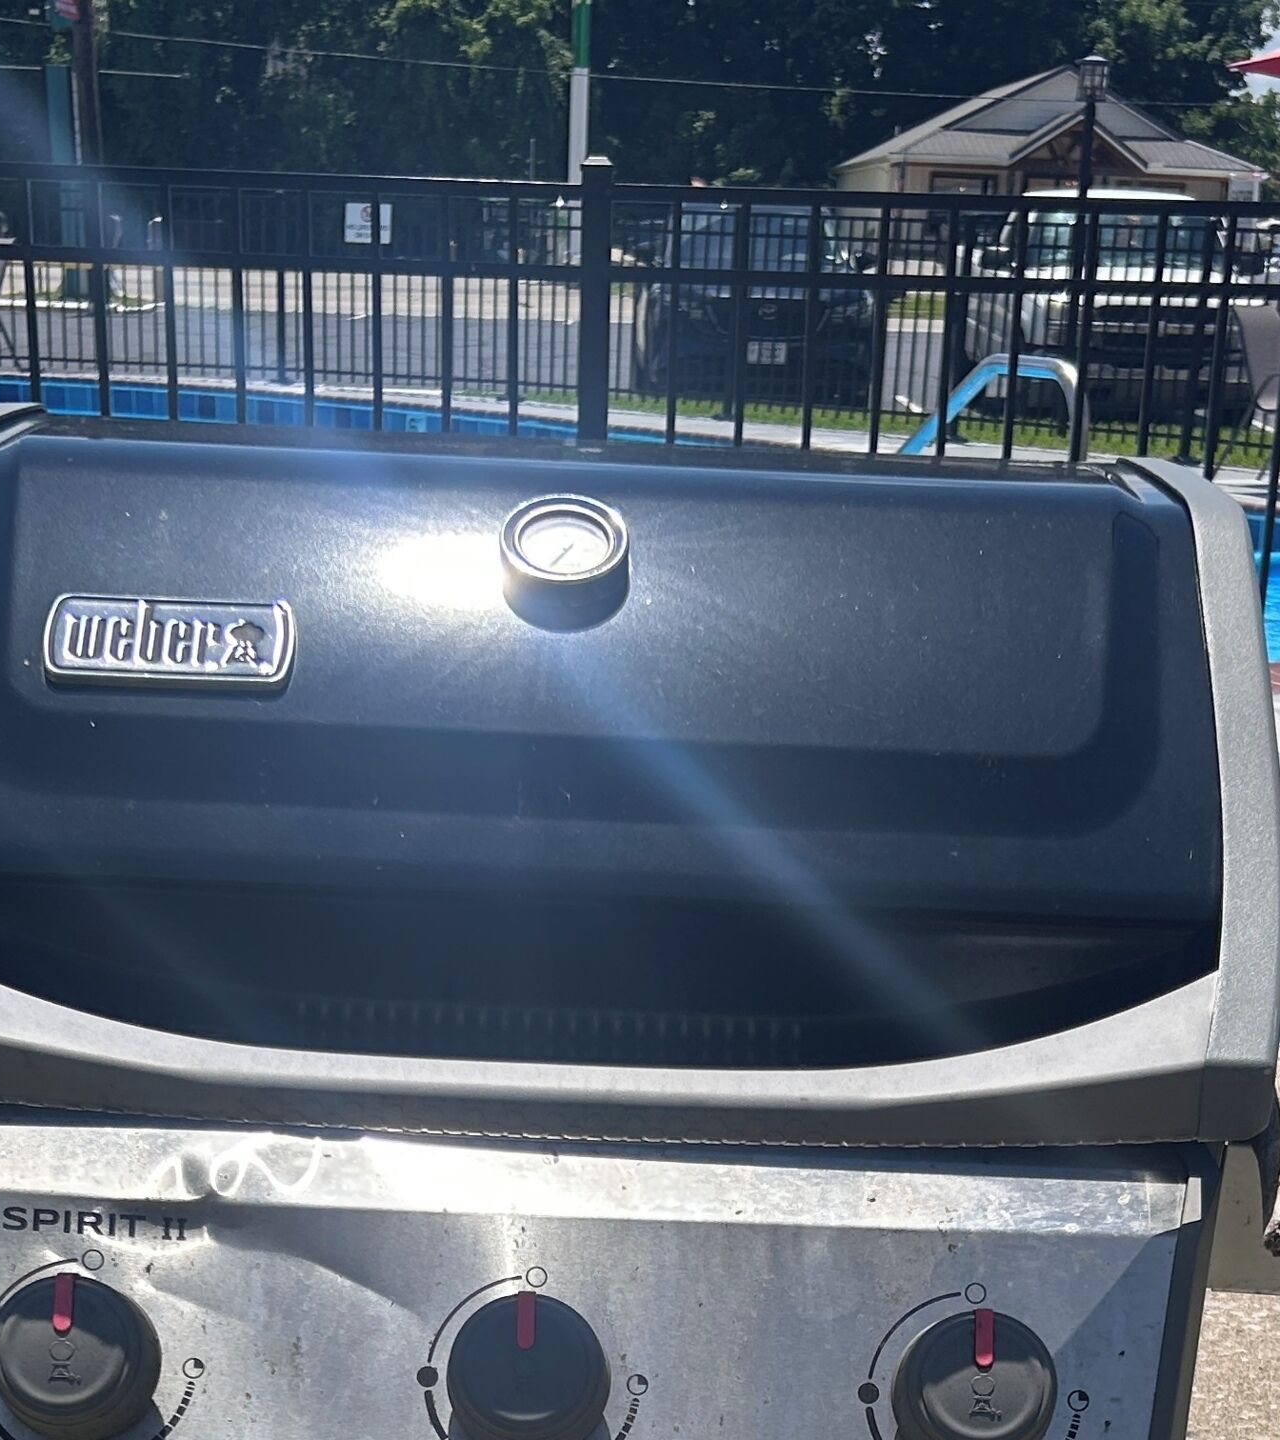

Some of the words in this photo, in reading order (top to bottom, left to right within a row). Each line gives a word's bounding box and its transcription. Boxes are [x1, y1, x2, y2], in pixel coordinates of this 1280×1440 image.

[62, 598, 220, 668] weber
[2, 1205, 147, 1239] SPIRIT
[161, 1216, 188, 1241] II
